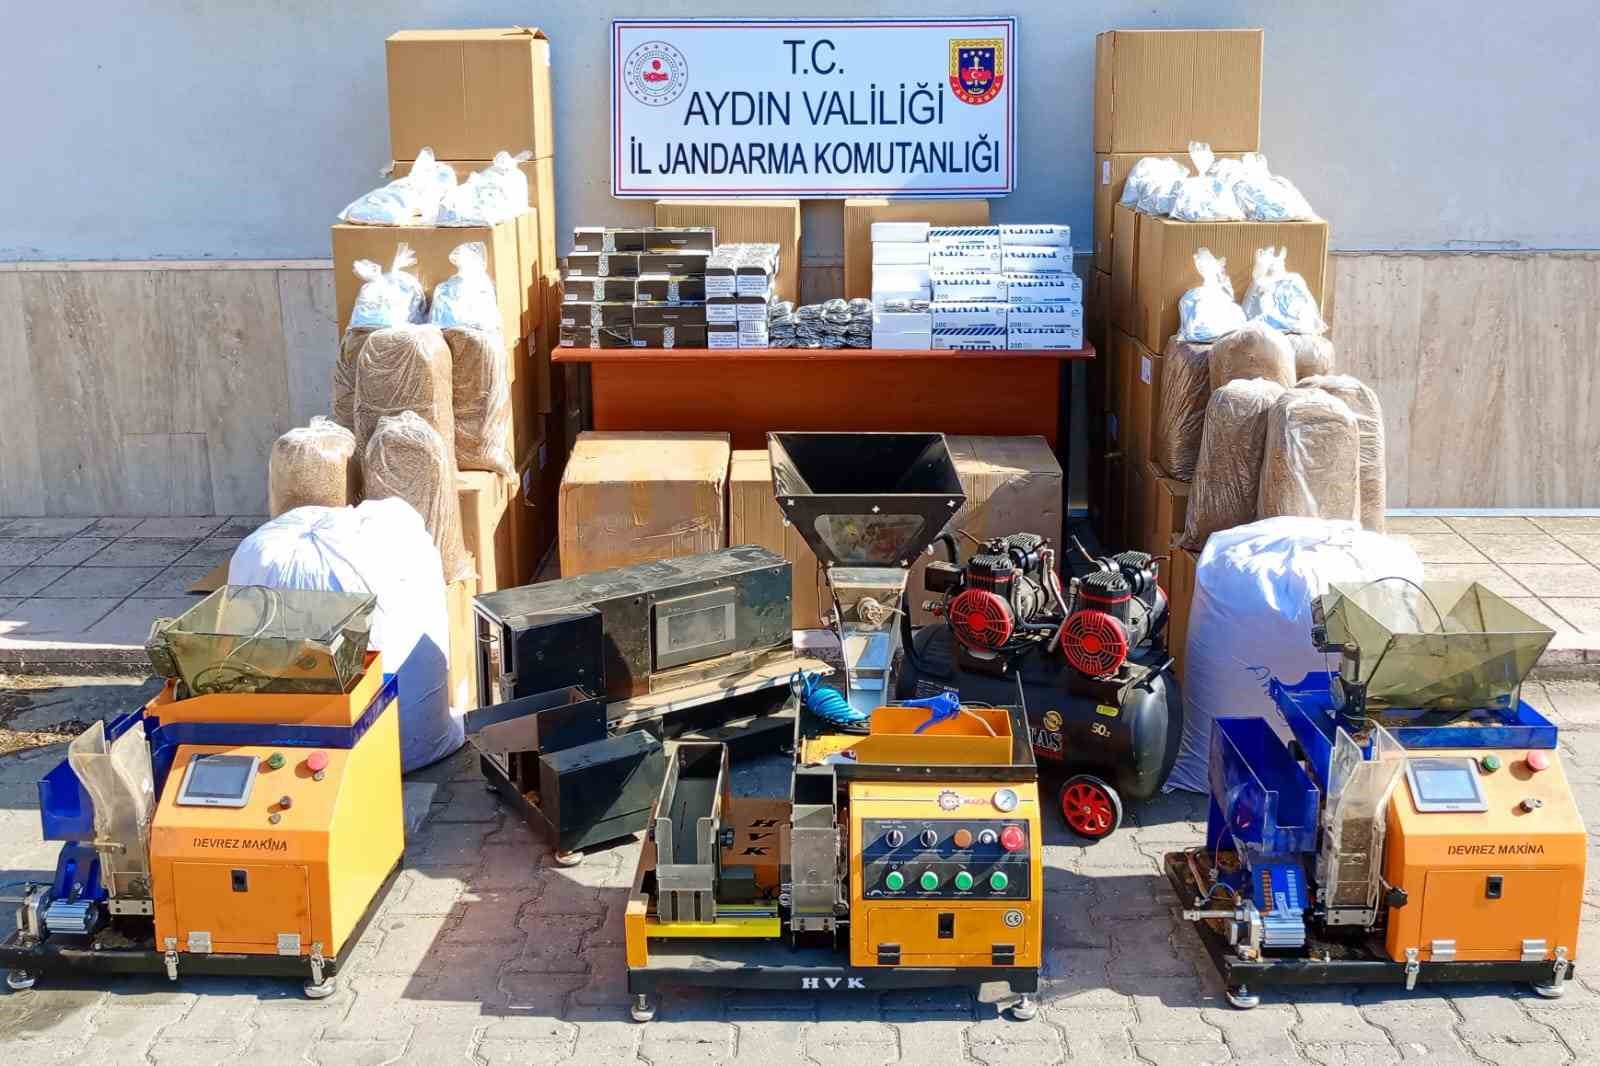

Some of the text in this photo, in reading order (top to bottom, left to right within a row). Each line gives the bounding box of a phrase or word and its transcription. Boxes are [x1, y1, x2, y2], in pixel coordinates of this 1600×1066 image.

[783, 39, 844, 75] T.C.
[684, 82, 944, 126] AYDIN VALİLİĞİ
[630, 134, 999, 174] İL JANDARMA KOMUTANLIĞI
[193, 838, 240, 849] DEVREZ
[1447, 845, 1496, 855] DEVREZ
